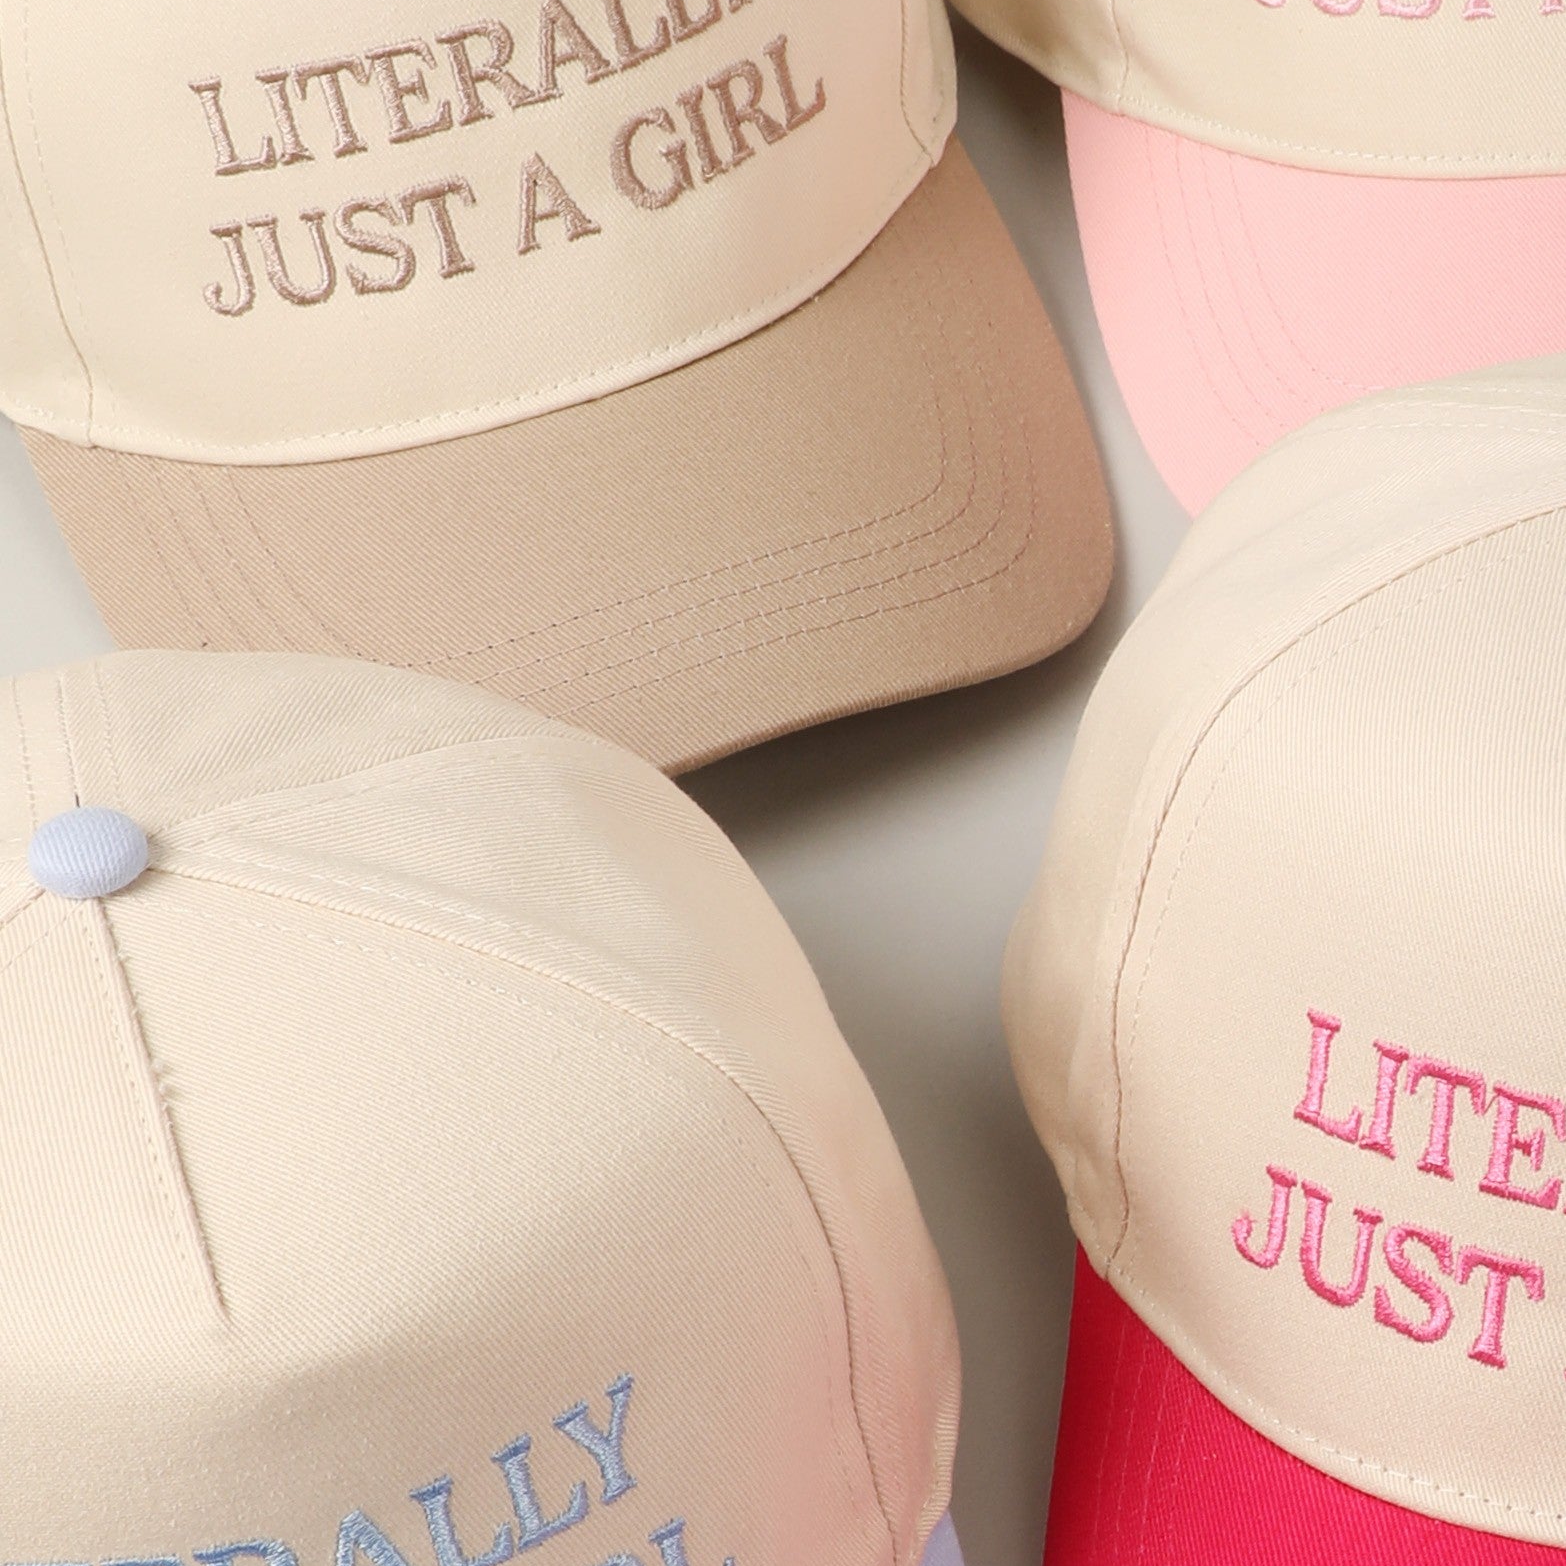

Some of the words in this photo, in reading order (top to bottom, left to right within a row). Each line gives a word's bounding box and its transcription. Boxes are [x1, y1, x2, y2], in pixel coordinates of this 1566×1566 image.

[202, 174, 478, 317] JUST
[515, 151, 602, 255] A
[608, 33, 828, 212] GIRL
[1231, 1163, 1545, 1369] JUST
